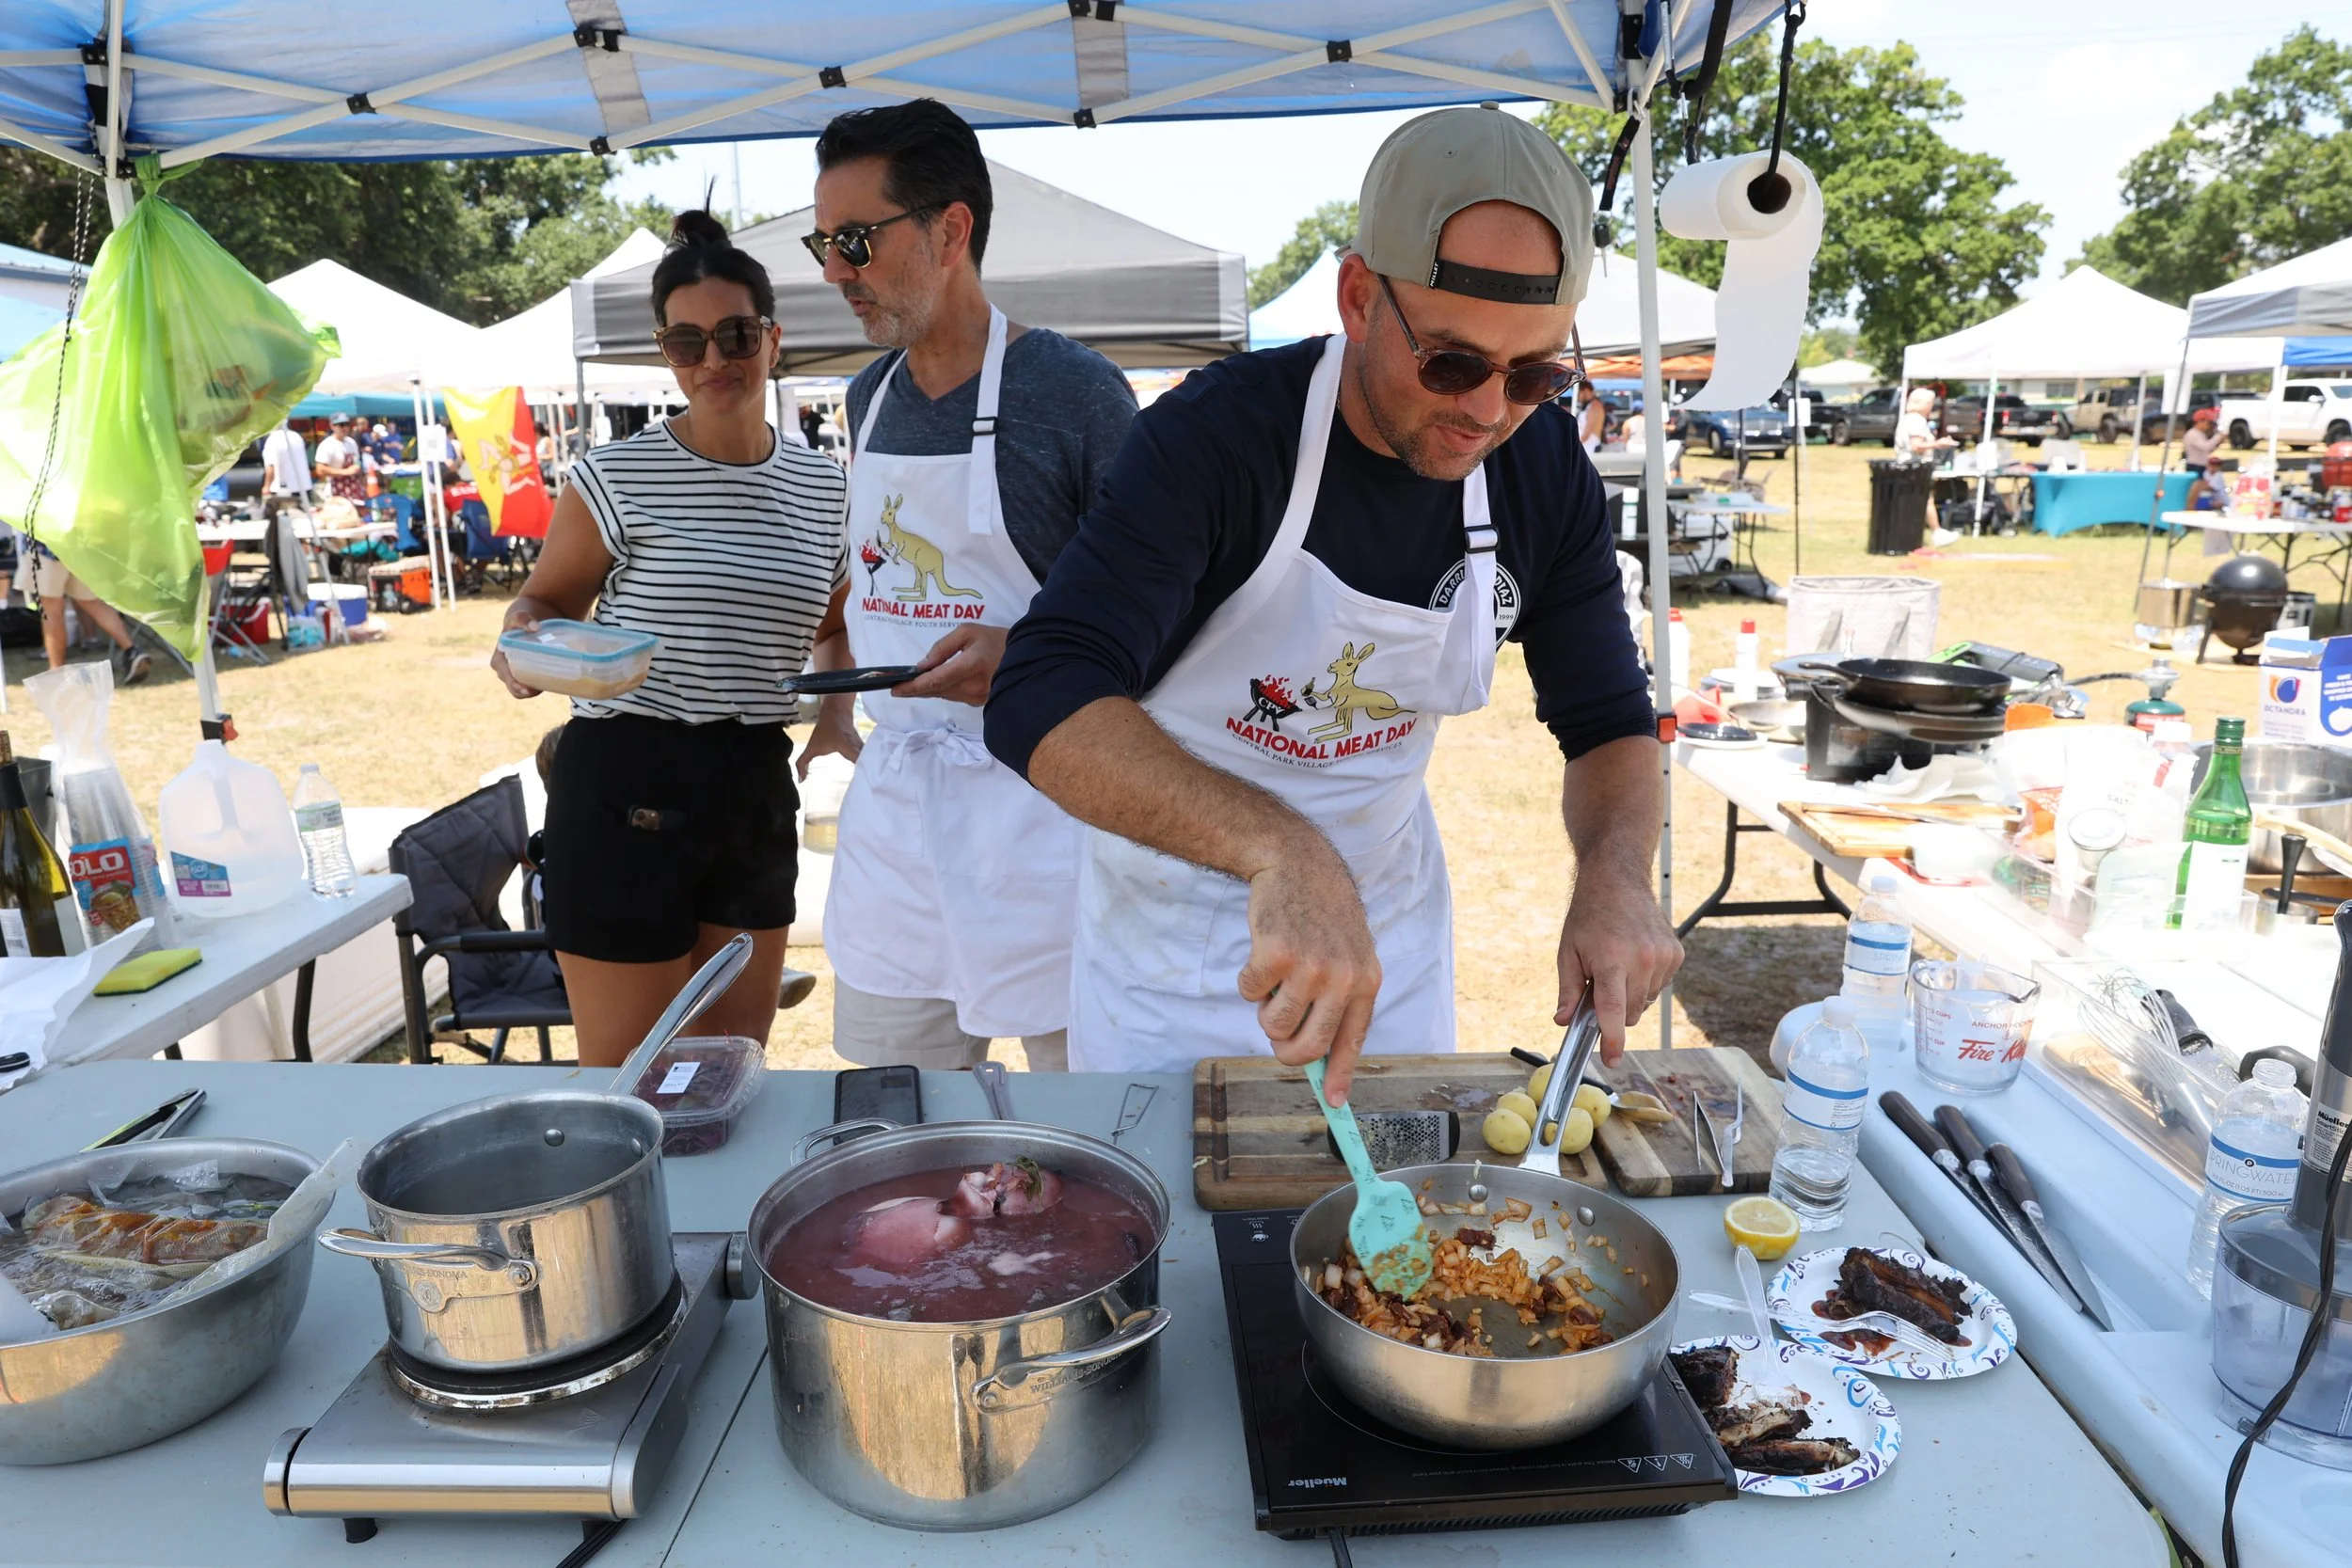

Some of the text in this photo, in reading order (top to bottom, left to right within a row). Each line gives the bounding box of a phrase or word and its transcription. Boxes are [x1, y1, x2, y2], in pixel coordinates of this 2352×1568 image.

[1438, 569, 1465, 604] DARRI
[913, 604, 951, 619] MEAT
[953, 605, 986, 620] DAY
[1226, 717, 1418, 761] NATIONAL MEAT DAY
[1232, 734, 1270, 759] CENTRAL
[1271, 752, 1295, 767] PARK
[1297, 760, 1333, 769] VILLAGE
[1971, 1020, 2009, 1030] ANCHOR
[2315, 1117, 2345, 1134] SmartStic
[2209, 1149, 2297, 1184] PRINGWATE
